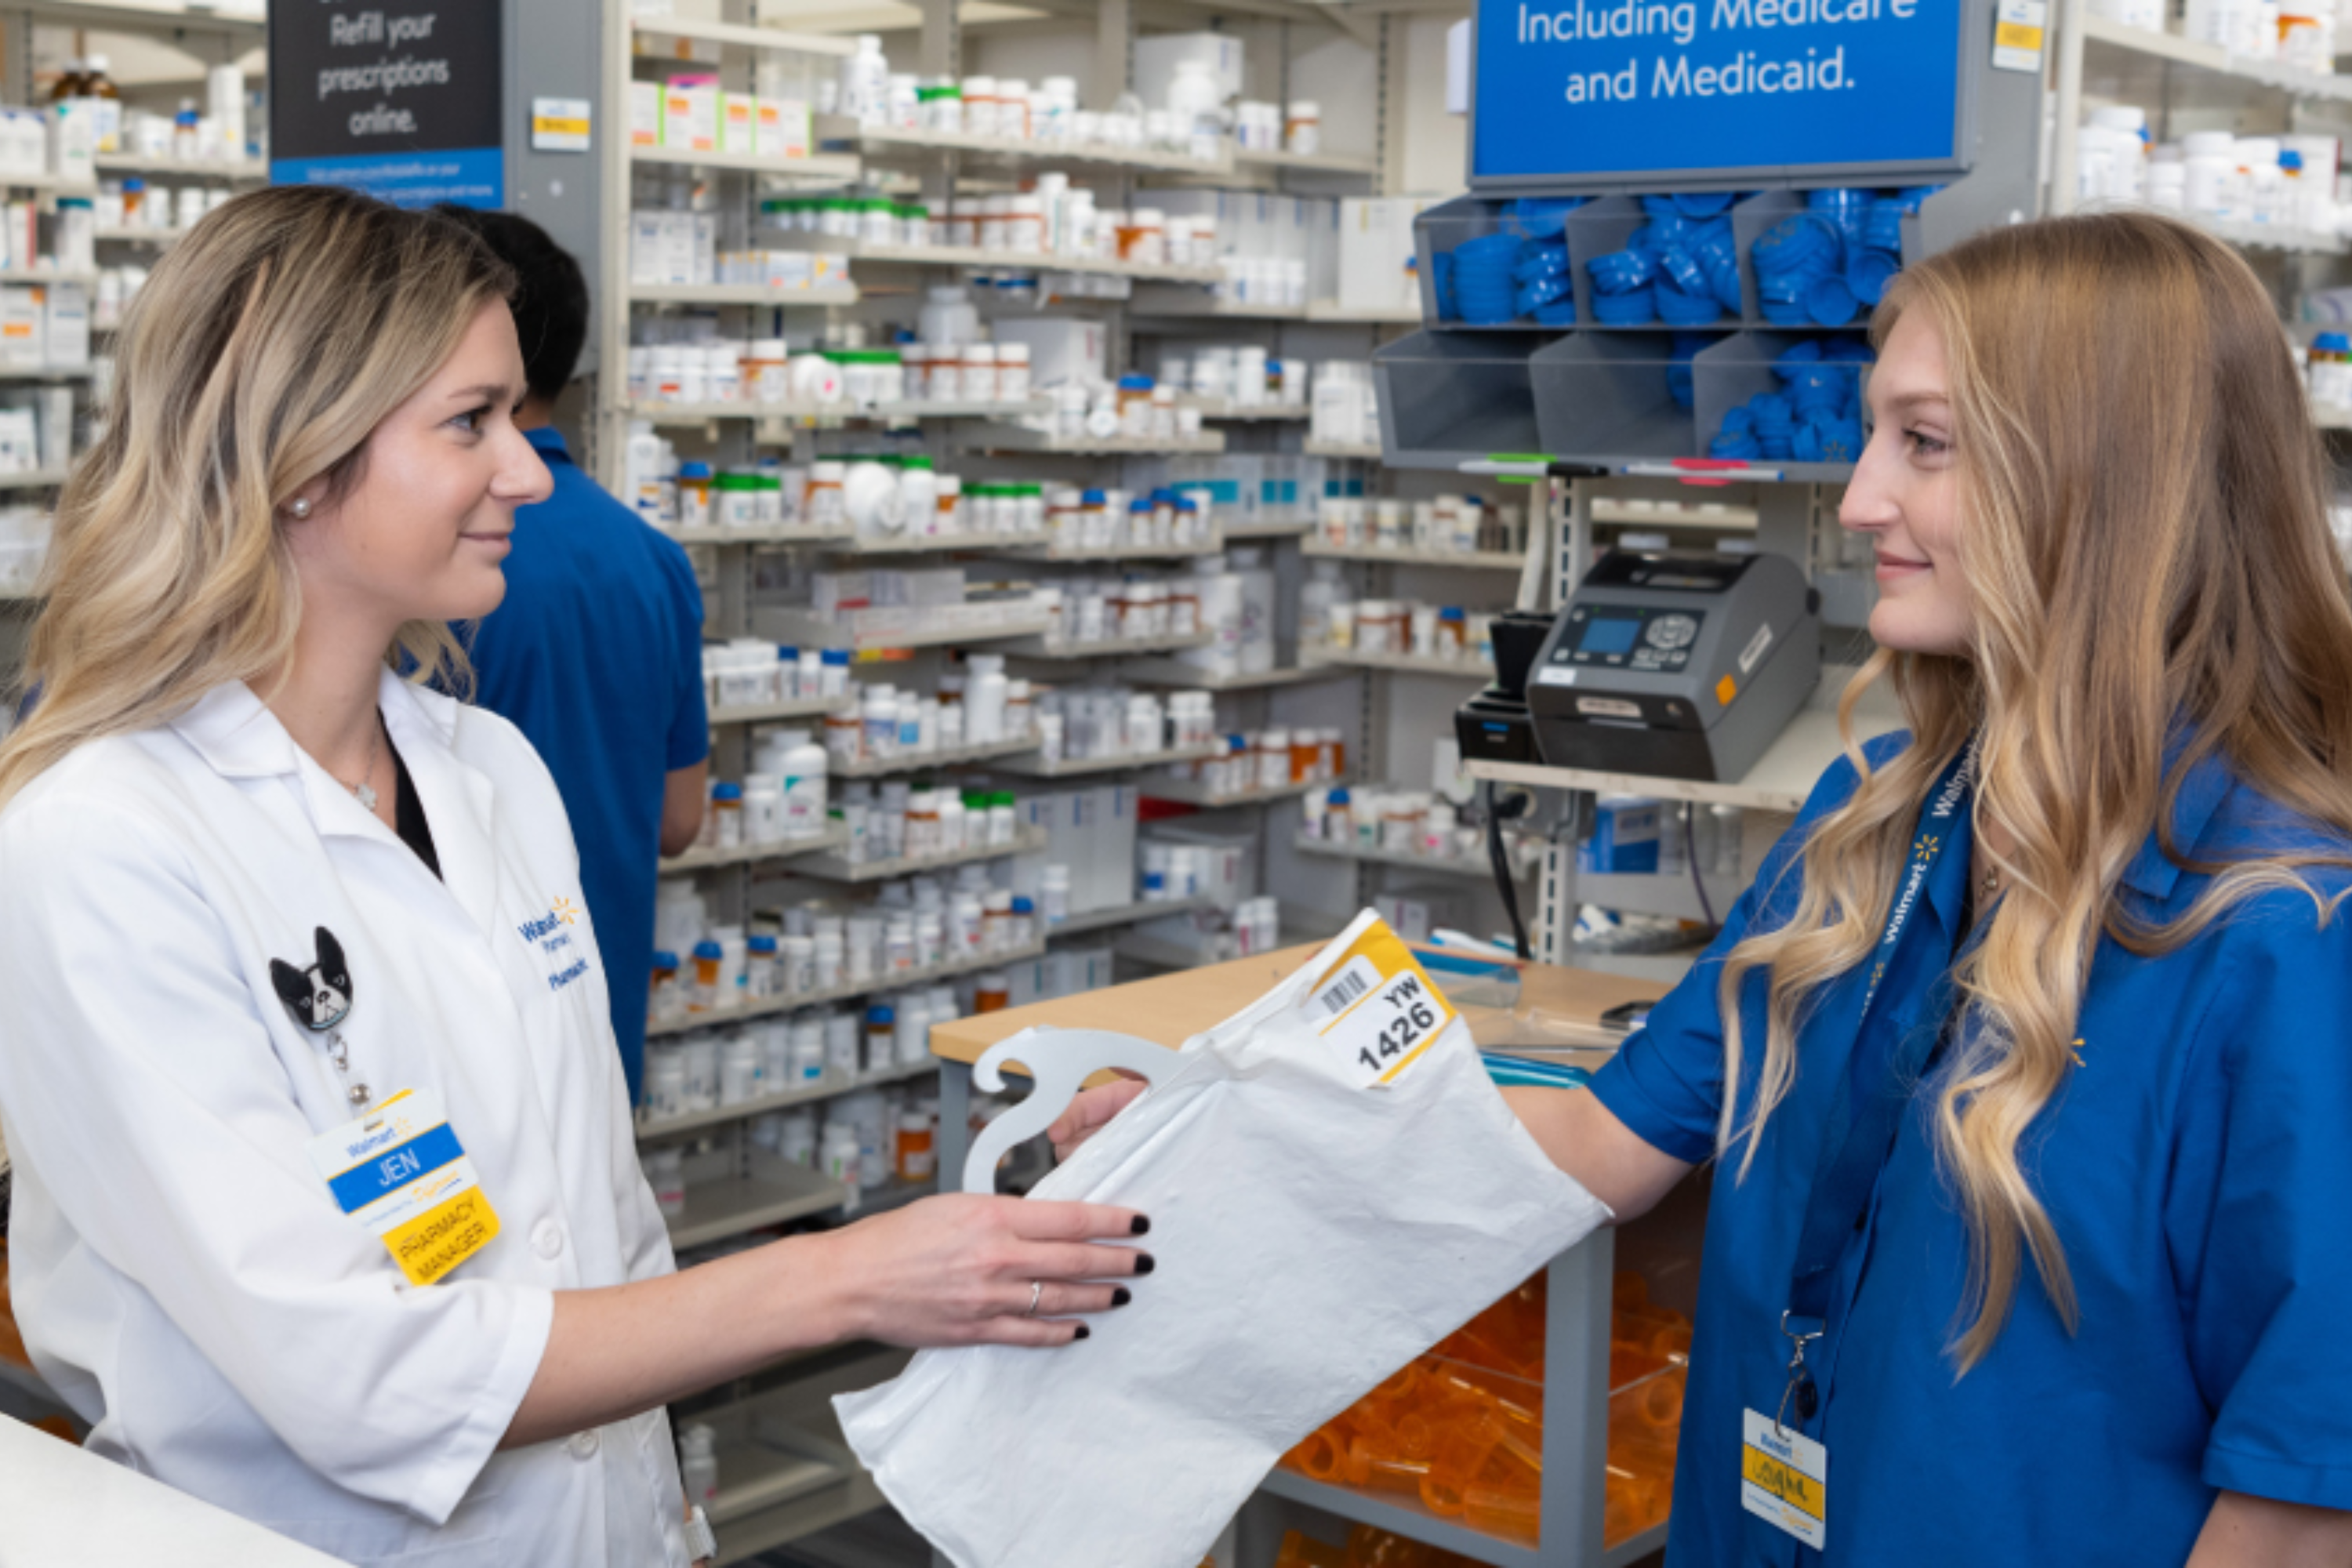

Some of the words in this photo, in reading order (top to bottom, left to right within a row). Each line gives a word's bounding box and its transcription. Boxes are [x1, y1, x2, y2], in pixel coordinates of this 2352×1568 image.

[329, 11, 384, 46] Refill
[387, 12, 437, 51] your
[1517, 0, 1696, 45] Including
[1710, 0, 1917, 31] Medicare
[318, 53, 449, 102] prescriptions
[1565, 58, 1637, 103] and
[1651, 45, 1856, 99] Medicaid.
[349, 102, 419, 136] online.
[1883, 862, 1927, 945] Walmart
[1382, 975, 1421, 1008] YW
[1357, 1002, 1435, 1071] 1426
[379, 1147, 421, 1188] JEN
[397, 1196, 477, 1264] PHARMACY
[416, 1220, 488, 1280] MANAGER
